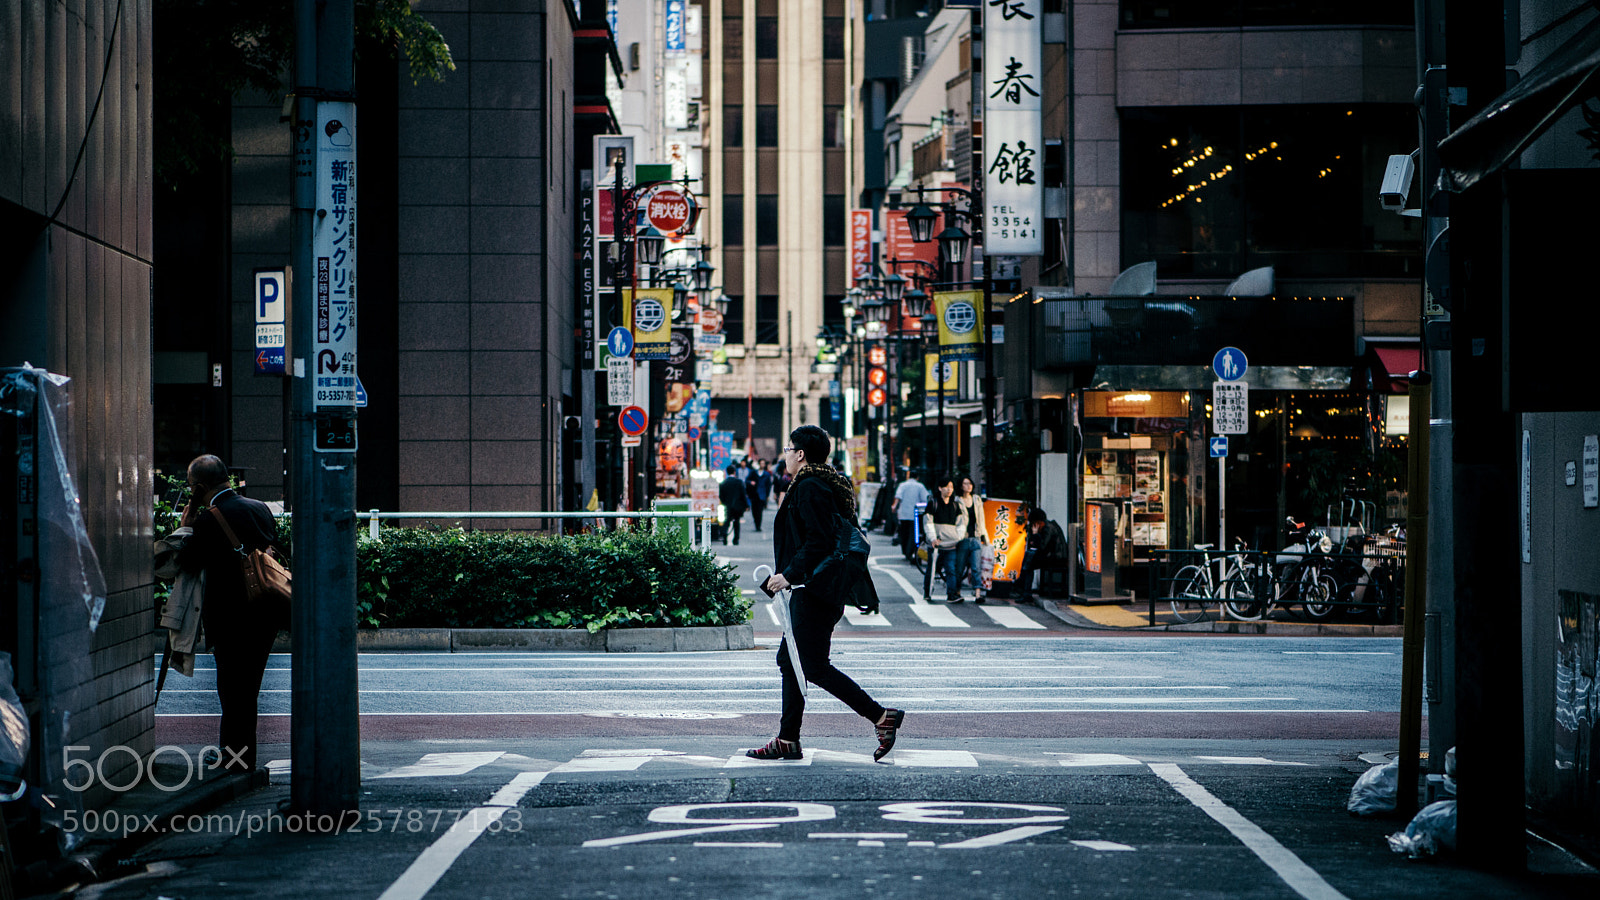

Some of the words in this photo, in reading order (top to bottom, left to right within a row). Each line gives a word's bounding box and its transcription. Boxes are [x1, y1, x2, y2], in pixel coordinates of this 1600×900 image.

[651, 202, 686, 219] 消火栓
[992, 206, 1015, 214] TEL
[583, 197, 592, 260] PLAZA
[992, 216, 1031, 226] 3354
[991, 229, 1036, 239] -5141
[331, 160, 348, 342] 新宿サンクリニック
[584, 268, 592, 305] EST
[259, 277, 279, 317] P
[319, 259, 328, 341] 夜23時まで診療
[257, 335, 283, 345] 新宿3丁目
[583, 308, 592, 360] 新宿3丁目
[269, 356, 284, 365] この先
[665, 366, 683, 380] 2F
[327, 432, 351, 444] 2-6
[993, 504, 1010, 568] 炭火焼肉
